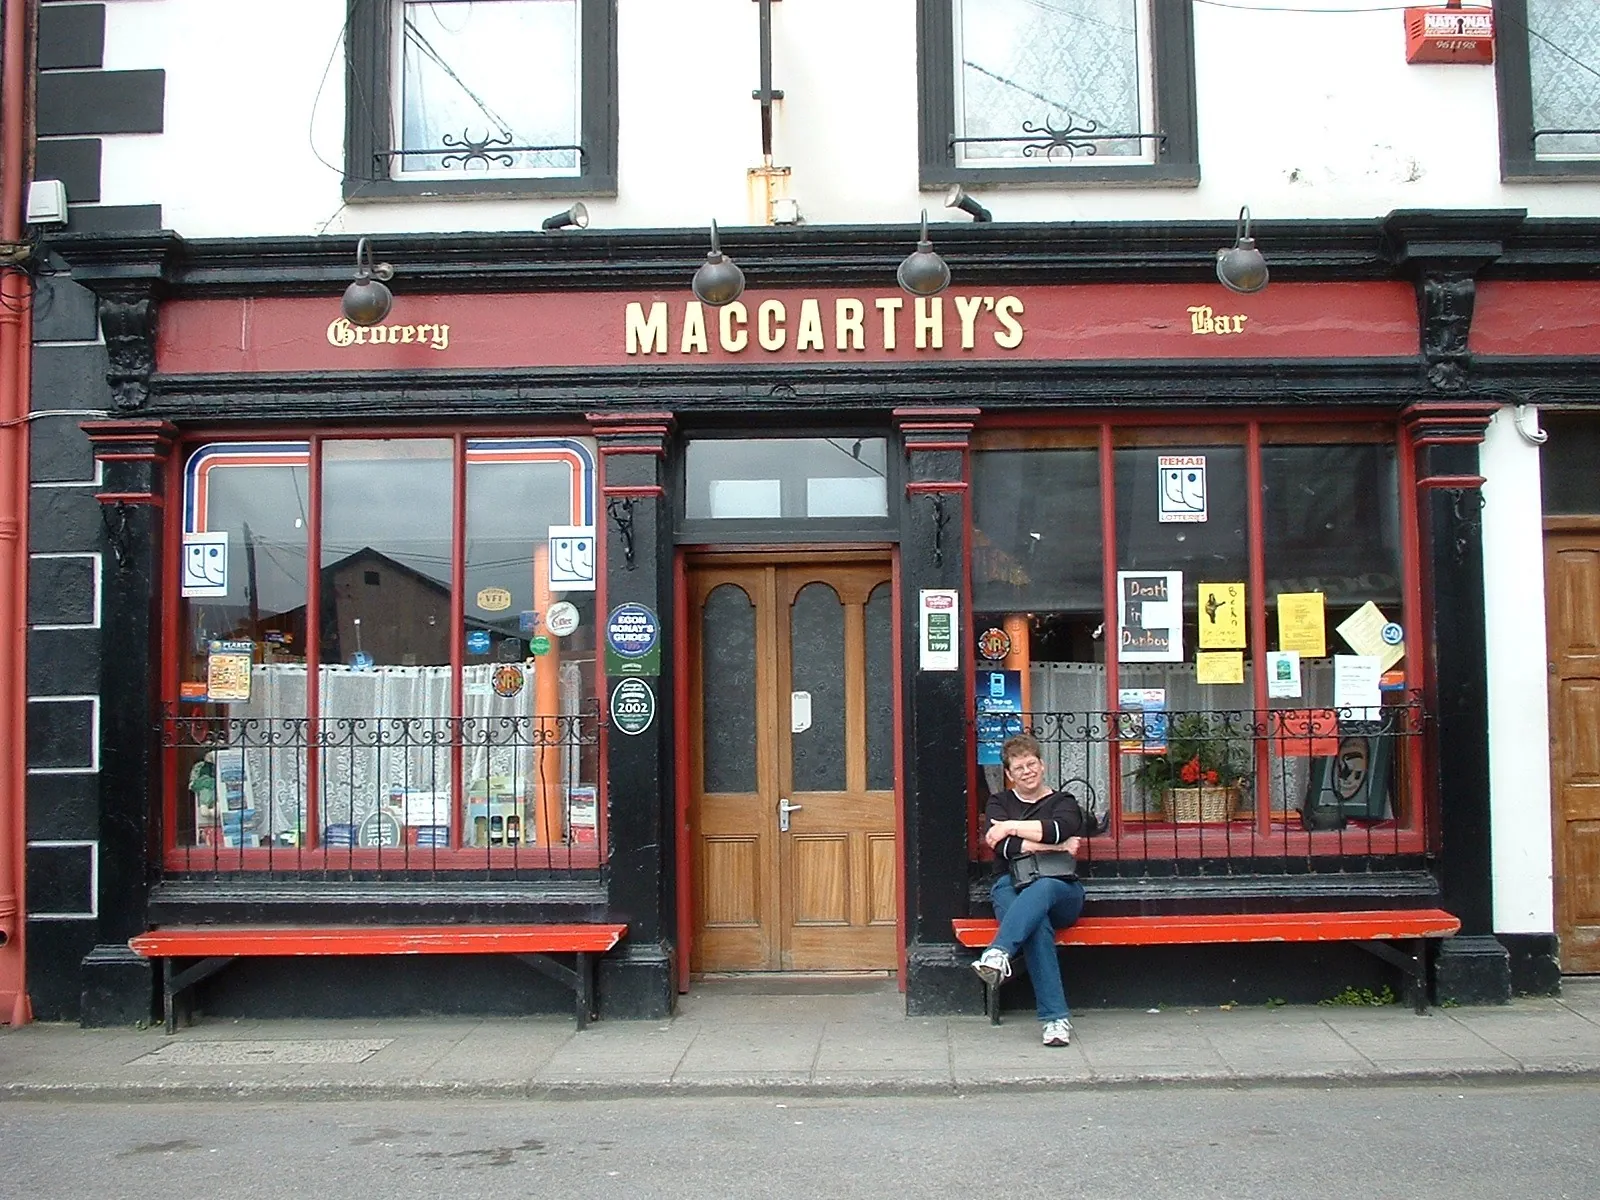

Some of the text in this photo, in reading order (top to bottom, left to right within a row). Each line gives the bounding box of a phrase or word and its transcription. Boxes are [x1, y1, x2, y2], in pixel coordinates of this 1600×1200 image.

[624, 295, 1025, 355] MACCARTHY'S
[1186, 304, 1249, 335] Bar
[326, 317, 450, 350] Grocery
[1160, 457, 1204, 466] REHAB
[1131, 580, 1168, 597] Death
[617, 615, 647, 624] EGON
[613, 633, 651, 642] GUIDES
[617, 702, 649, 713] 2002
